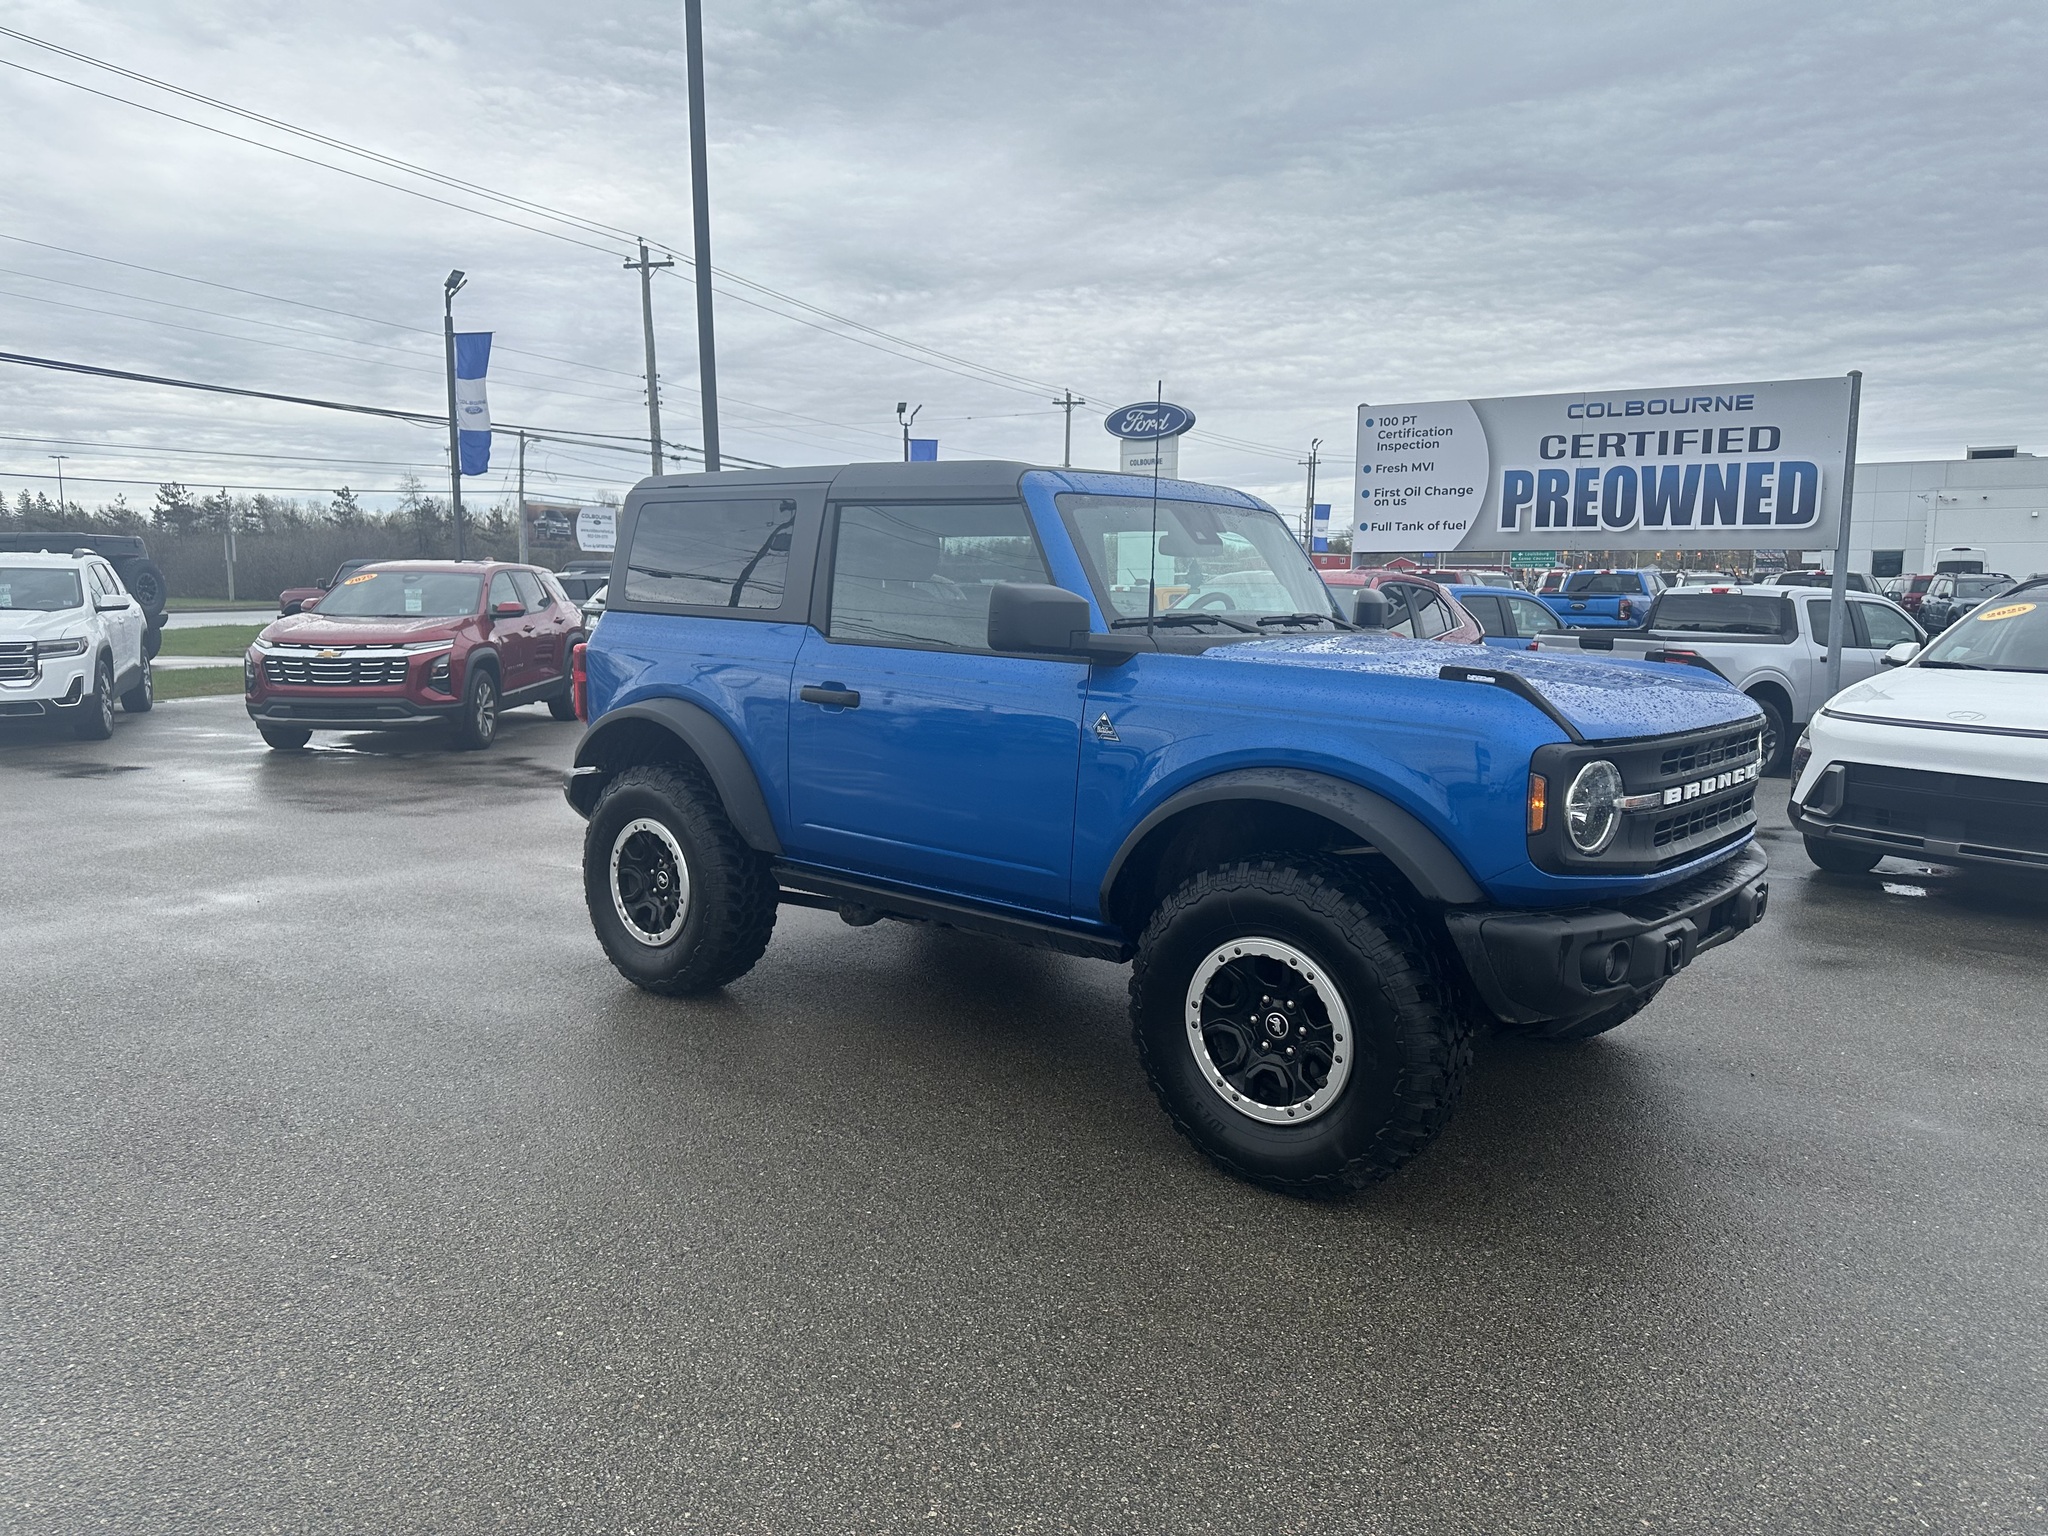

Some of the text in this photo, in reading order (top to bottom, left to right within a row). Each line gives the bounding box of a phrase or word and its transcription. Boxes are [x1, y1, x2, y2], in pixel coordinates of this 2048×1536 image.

[1567, 394, 1755, 419] COLBOURNE
[1121, 409, 1171, 433] Ford
[1379, 415, 1417, 427] 100 PT
[1378, 427, 1453, 439] Certification
[1377, 439, 1440, 452] Inspection
[1540, 426, 1781, 460] CERTIFIED
[1375, 462, 1434, 473] Fresh MVI
[1374, 486, 1474, 498] First Oil Change
[1500, 460, 1819, 529] PREOWNED
[1374, 497, 1407, 506] on us
[1371, 520, 1467, 532] Full Tank of fuel
[1663, 763, 1758, 806] BRONCO
